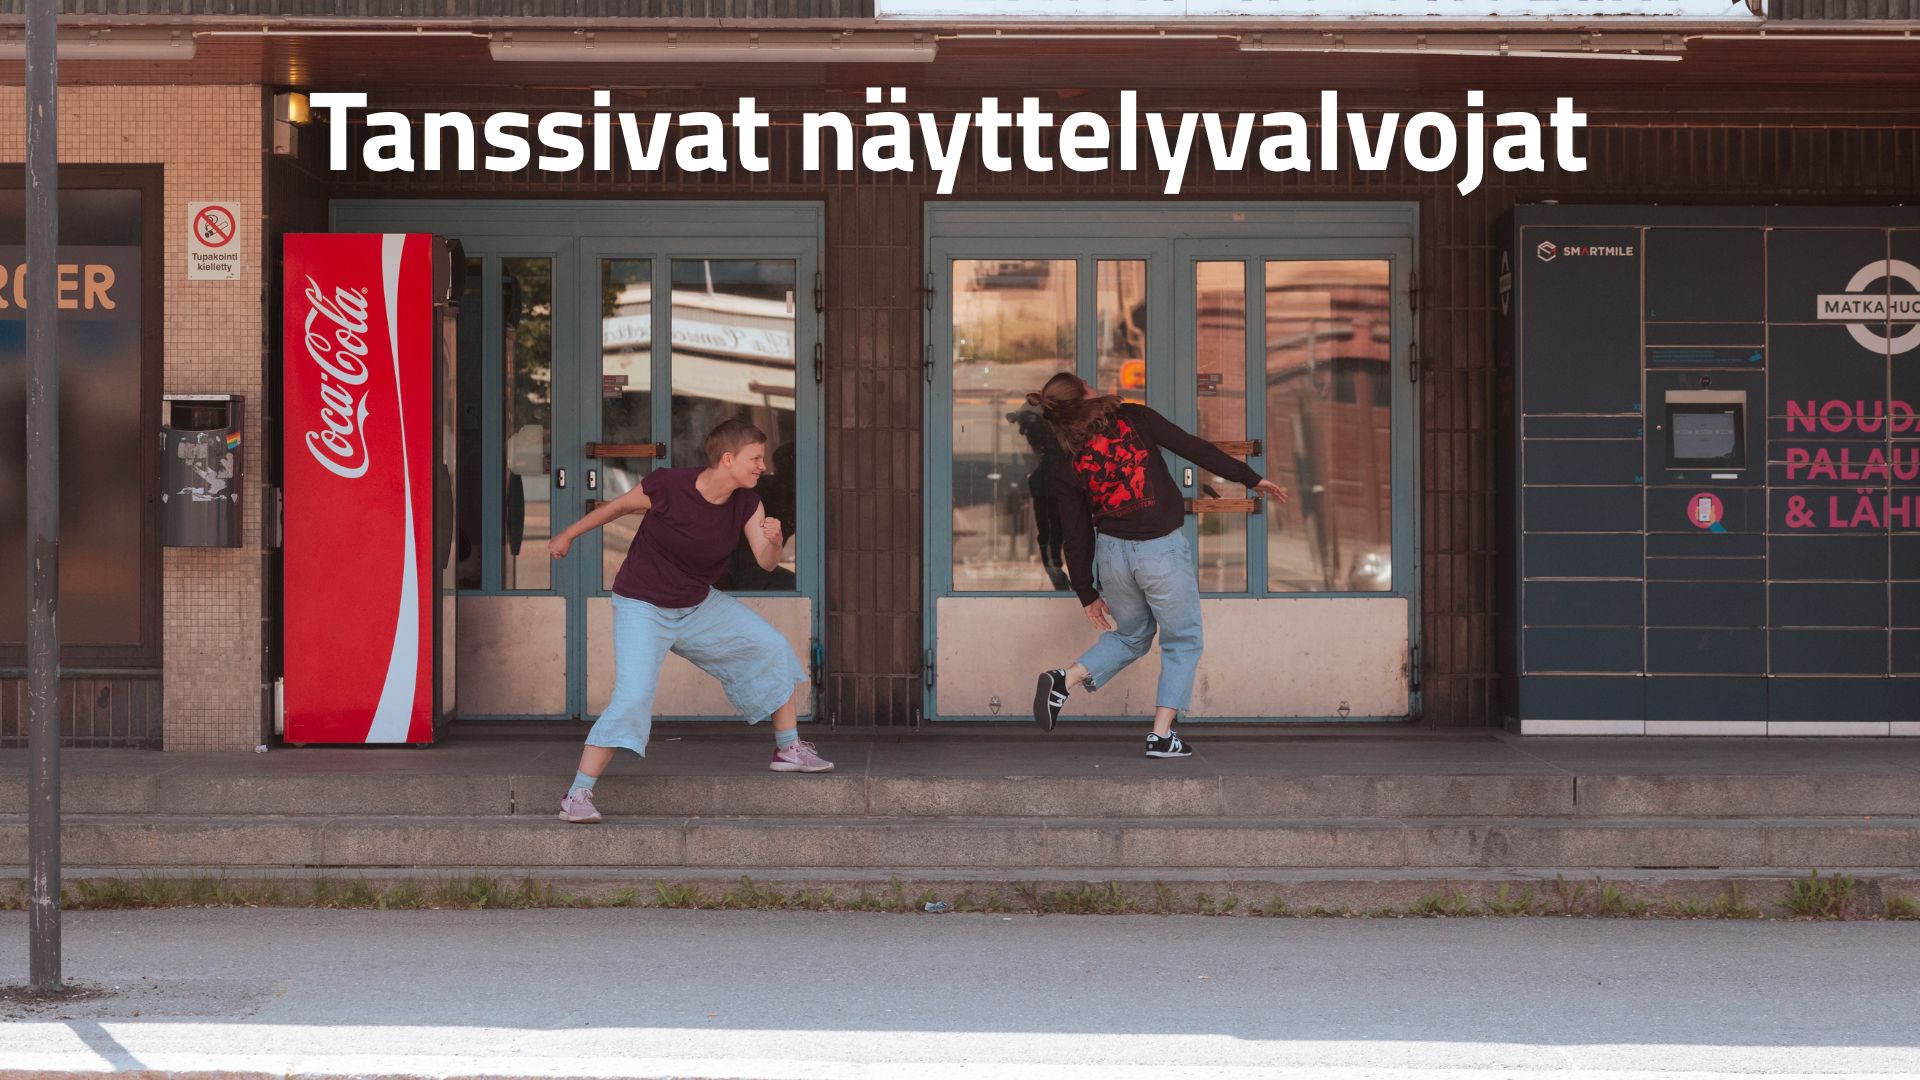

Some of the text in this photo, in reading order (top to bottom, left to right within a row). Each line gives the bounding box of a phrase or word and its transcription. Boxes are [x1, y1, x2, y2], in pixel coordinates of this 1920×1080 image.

[192, 252, 238, 263] Tupakointi
[1563, 246, 1634, 256] SMARTMILE
[197, 263, 232, 273] kielletty
[305, 273, 370, 479] Coca-Cola
[1786, 399, 1920, 433] NOUD
[1785, 487, 1920, 528] & LÄH
